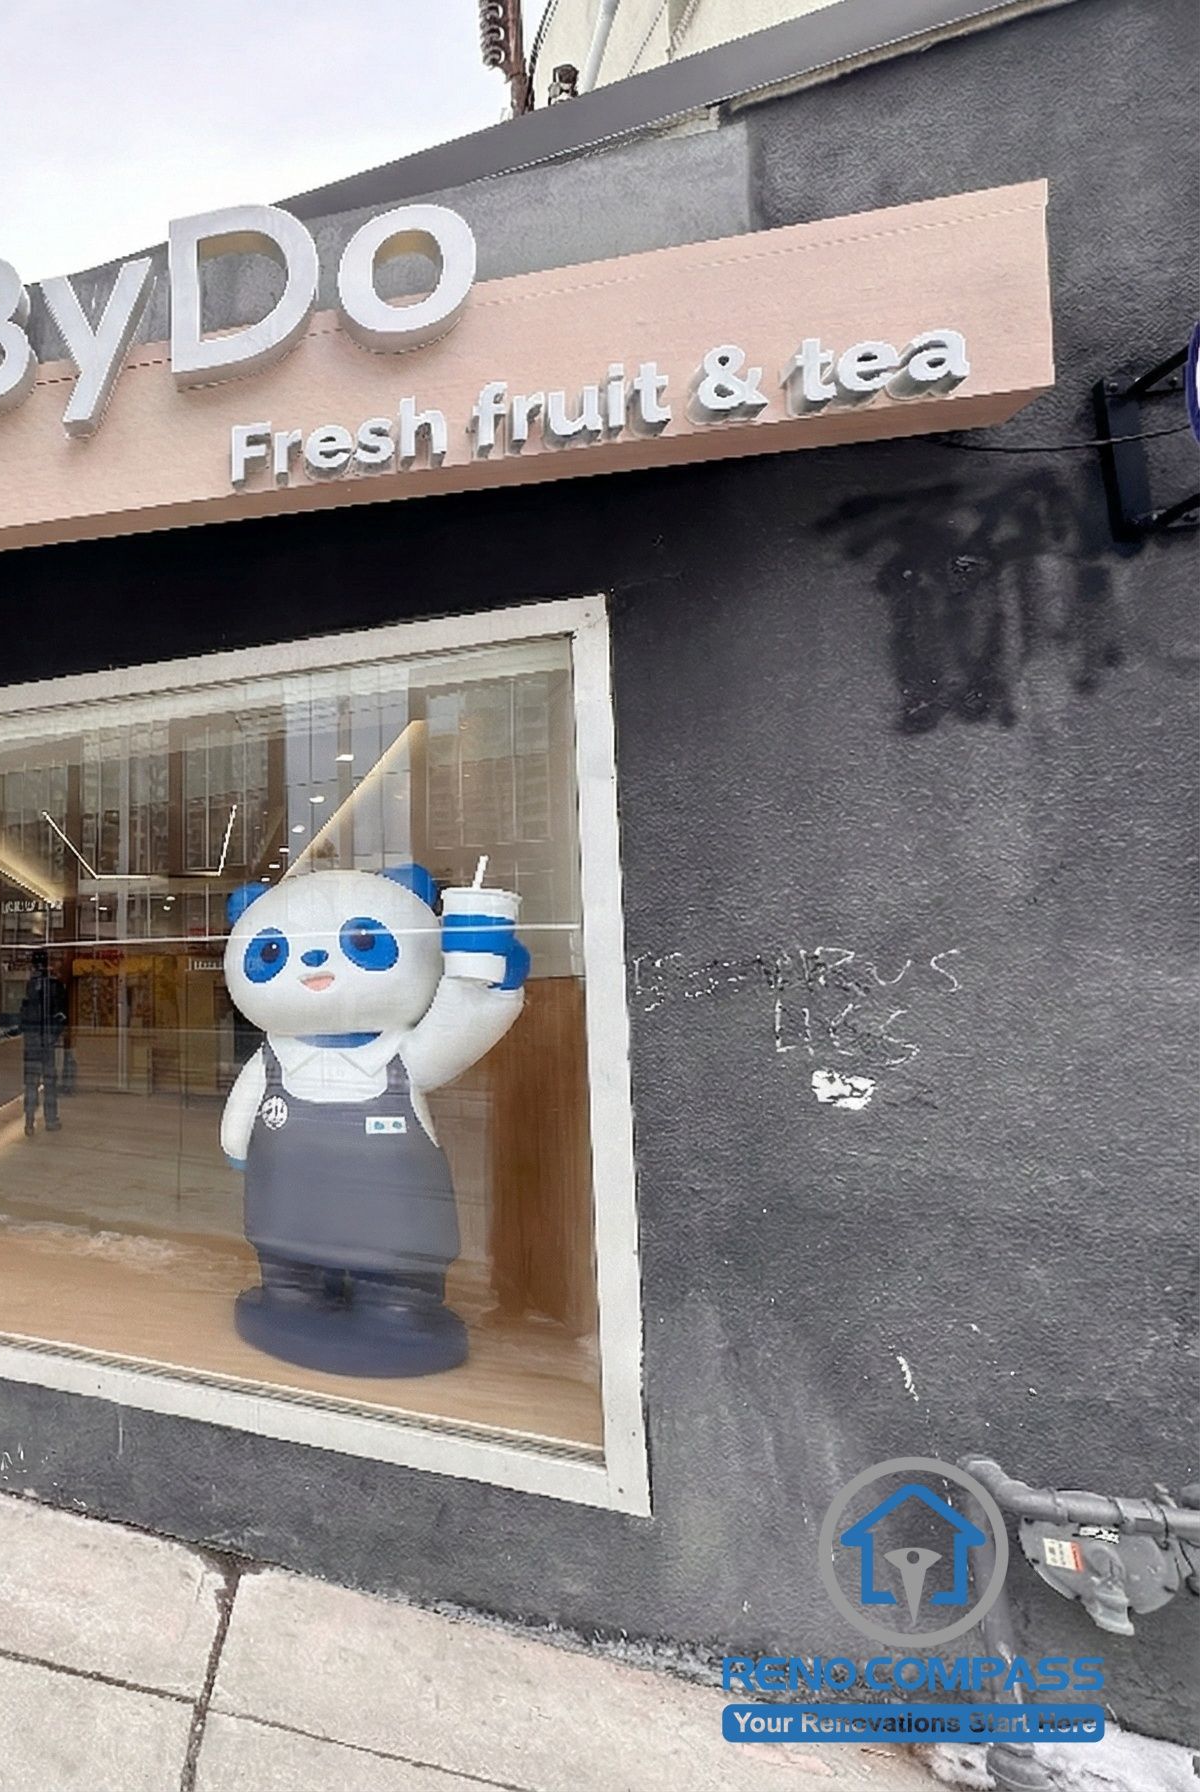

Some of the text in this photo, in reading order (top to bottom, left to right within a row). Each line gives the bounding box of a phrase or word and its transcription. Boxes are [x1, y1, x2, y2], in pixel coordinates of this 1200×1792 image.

[230, 328, 970, 490] Fresh fruit & tea
